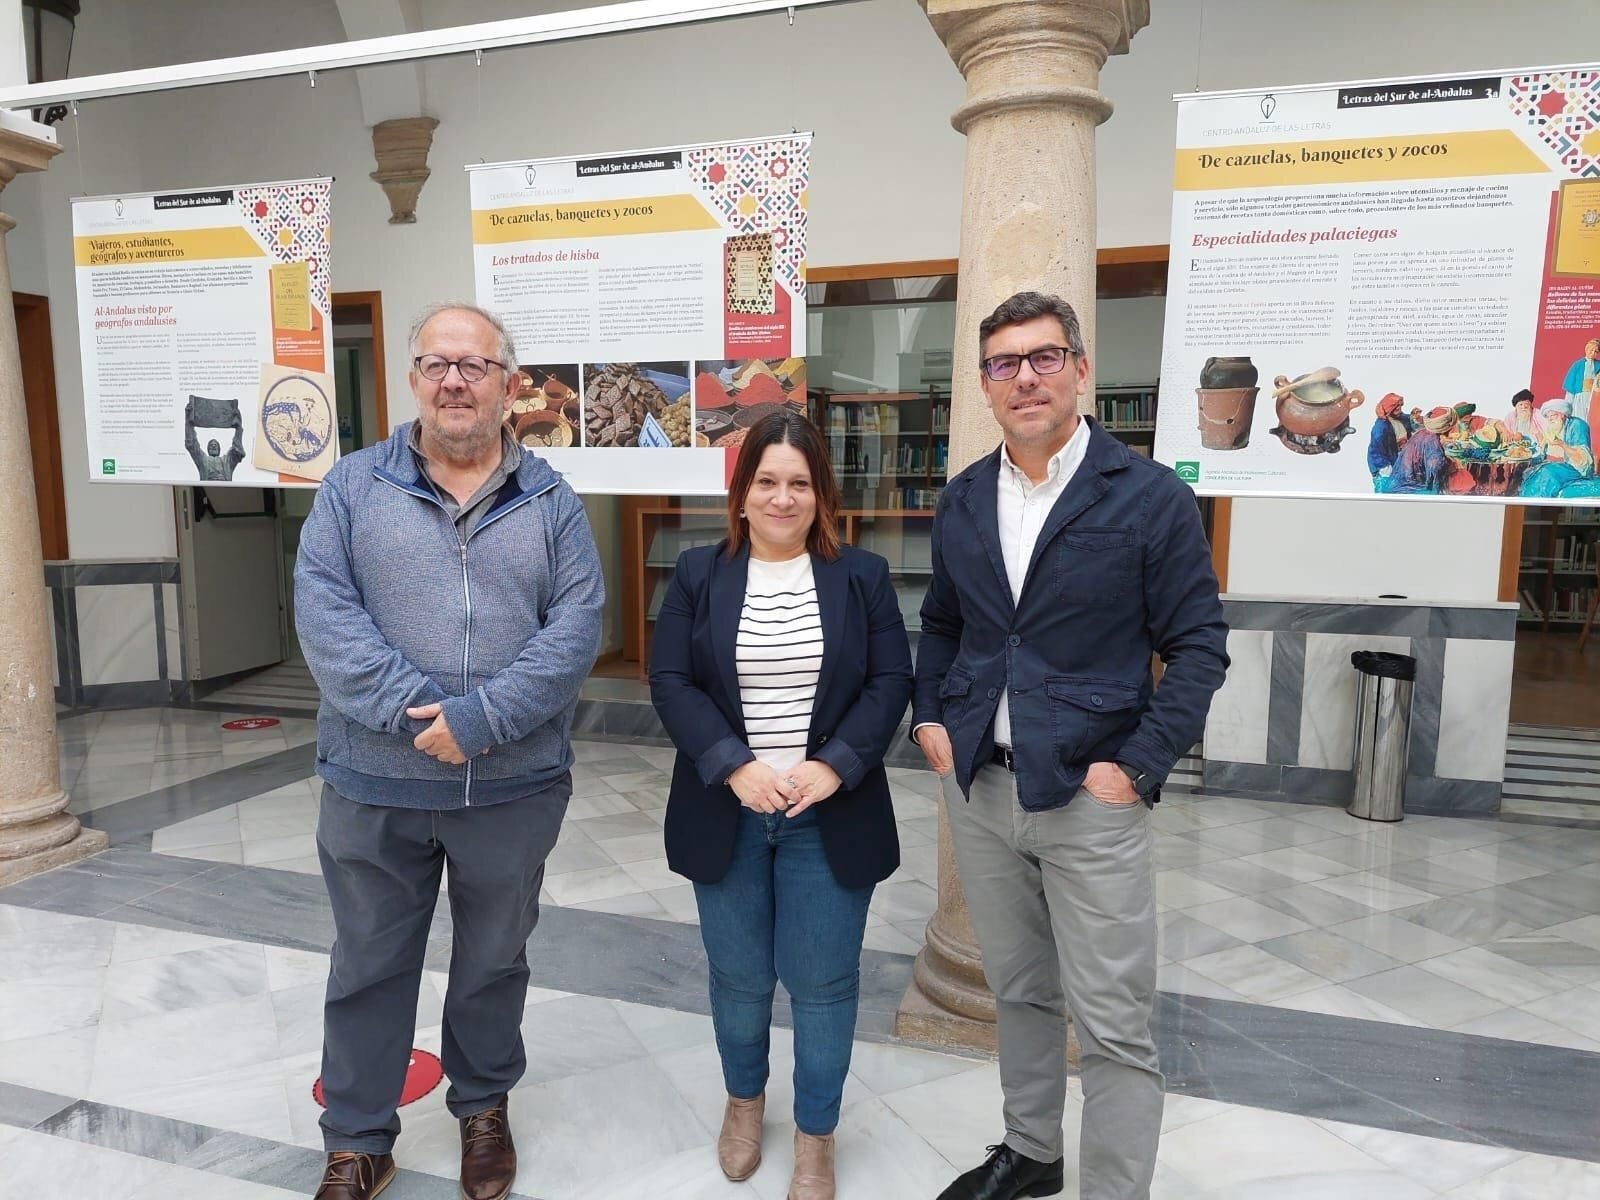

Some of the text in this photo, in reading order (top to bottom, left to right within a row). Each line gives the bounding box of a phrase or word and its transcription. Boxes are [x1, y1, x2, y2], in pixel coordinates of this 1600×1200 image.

[1343, 95, 1372, 104] Letras
[1374, 93, 1388, 102] del
[1390, 92, 1406, 102] Sur
[1408, 91, 1420, 100] de
[1422, 86, 1472, 99] al-Andalus
[1198, 144, 1448, 168] De cazuelas, banquetes y zocos
[579, 166, 600, 174] Letras
[600, 164, 610, 172] del
[610, 163, 622, 172] Sur
[622, 162, 630, 171] de
[631, 160, 664, 170] al-Andalus
[490, 205, 654, 226] De cazuelas, banquetes y zocos
[90, 237, 174, 252] Viajeros, estudiantes,
[1192, 226, 1398, 249] Especialidades palaciegas
[90, 248, 184, 263] geógrafos y aventureros
[492, 249, 600, 266] Los tratados de hisba
[95, 304, 173, 316] Al-Andalus visto por
[96, 318, 133, 330] geógrafos
